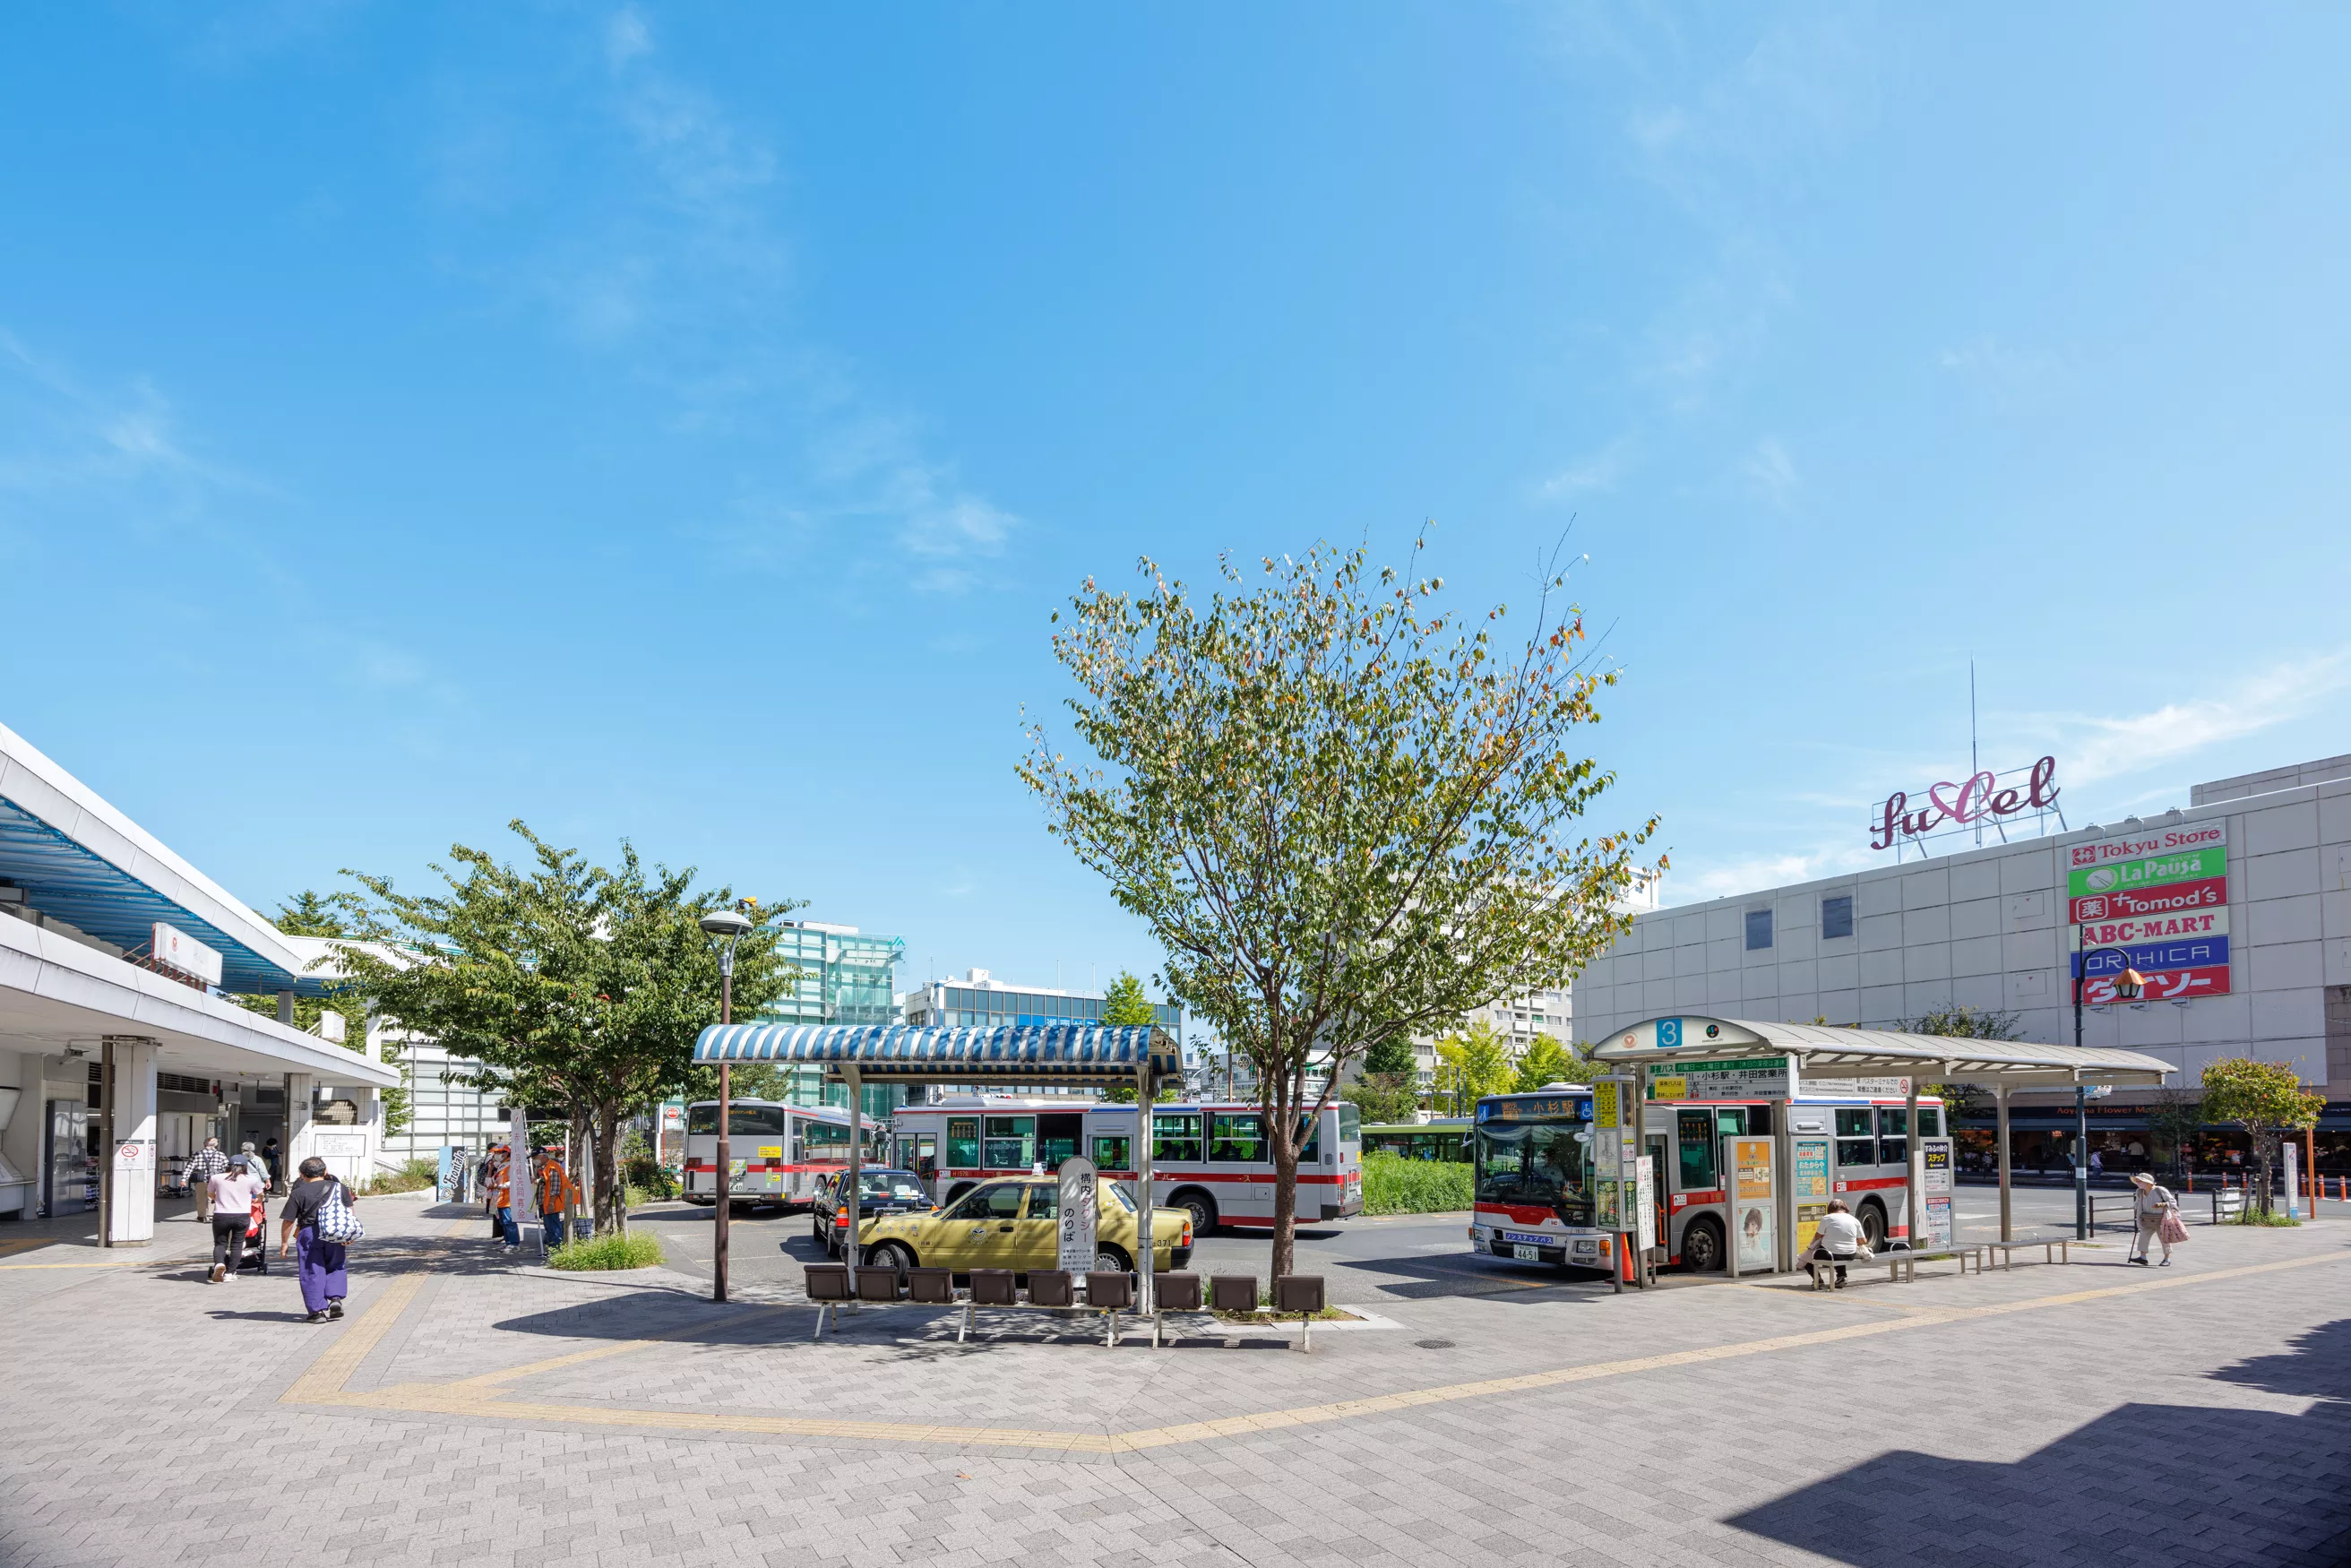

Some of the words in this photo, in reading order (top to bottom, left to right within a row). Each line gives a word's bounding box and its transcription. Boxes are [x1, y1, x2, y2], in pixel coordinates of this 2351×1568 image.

[2098, 840, 2158, 858] Tokyu
[2165, 829, 2221, 848] Store
[2081, 900, 2103, 918] 薬
[2083, 915, 2215, 945] ABC-MART
[2087, 945, 2209, 969] ORIHICA
[1662, 1021, 1677, 1046] 3
[1649, 1064, 1675, 1073] 深夜バス
[1533, 1099, 1575, 1115] 小杉駅
[2057, 1107, 2095, 1115] Aoyma
[2097, 1106, 2131, 1114] Flower
[1928, 1153, 1946, 1162] ステップ
[1081, 1173, 1091, 1243] 構内タクシー
[1064, 1208, 1075, 1242] のりば
[1506, 1233, 1553, 1244] ノンステップバス
[1518, 1251, 1537, 1261] 44-51
